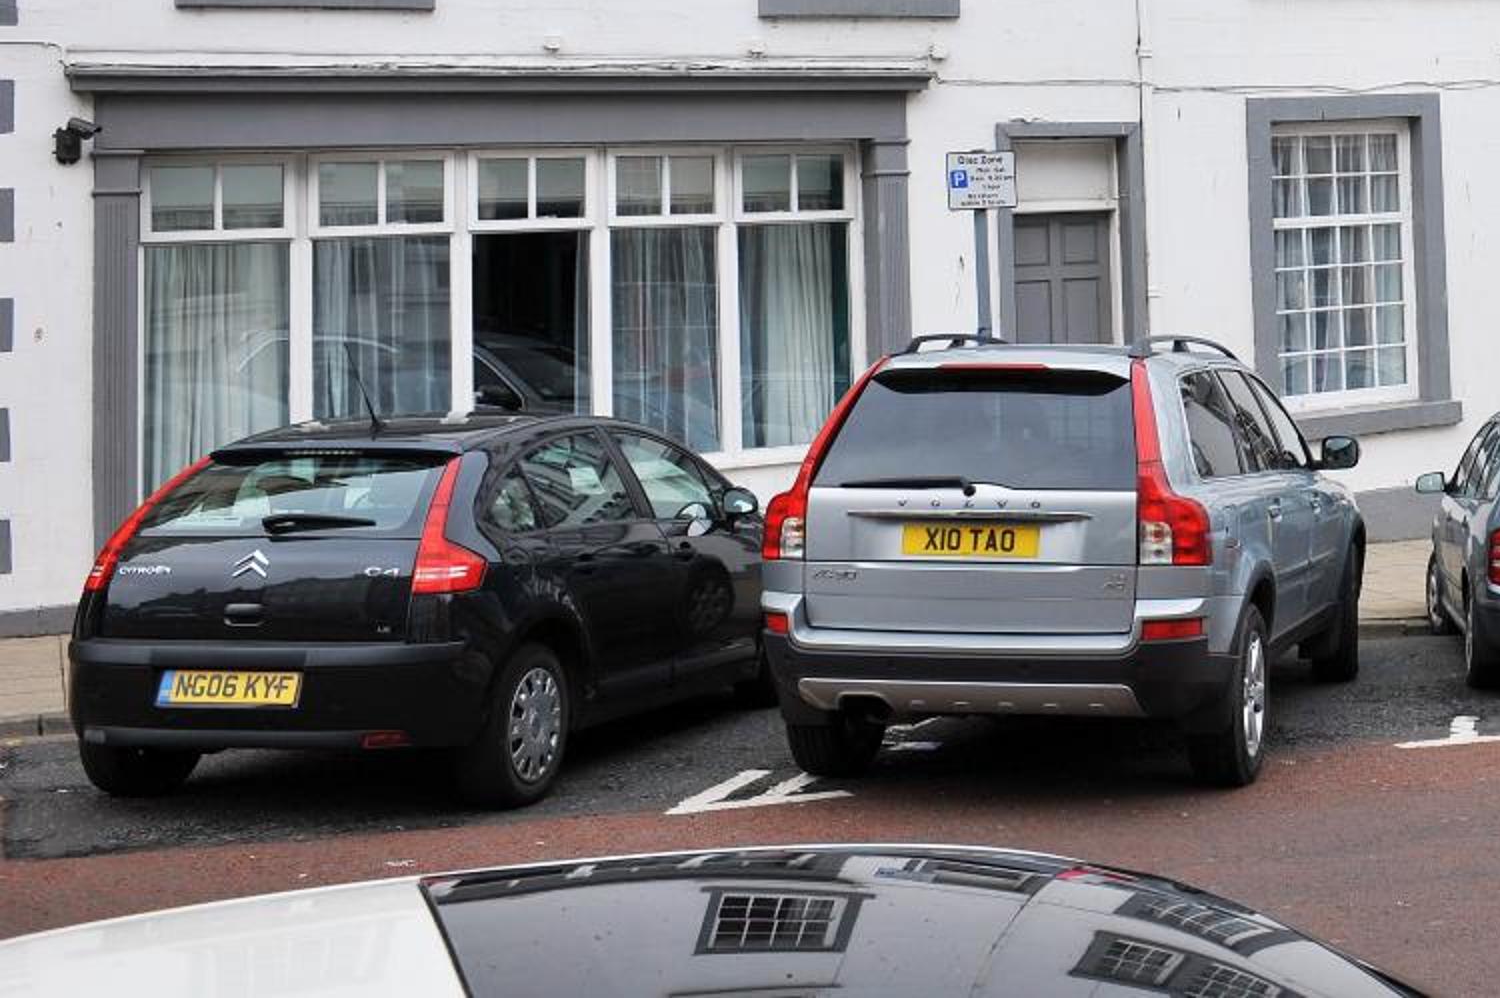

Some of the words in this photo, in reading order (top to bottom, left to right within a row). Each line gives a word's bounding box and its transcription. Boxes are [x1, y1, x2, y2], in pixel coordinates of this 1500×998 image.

[897, 501, 1041, 510] VOLVO
[924, 528, 961, 551] X10
[970, 529, 1015, 552] TAO
[175, 674, 238, 697] NG06
[244, 674, 294, 698] KYF
